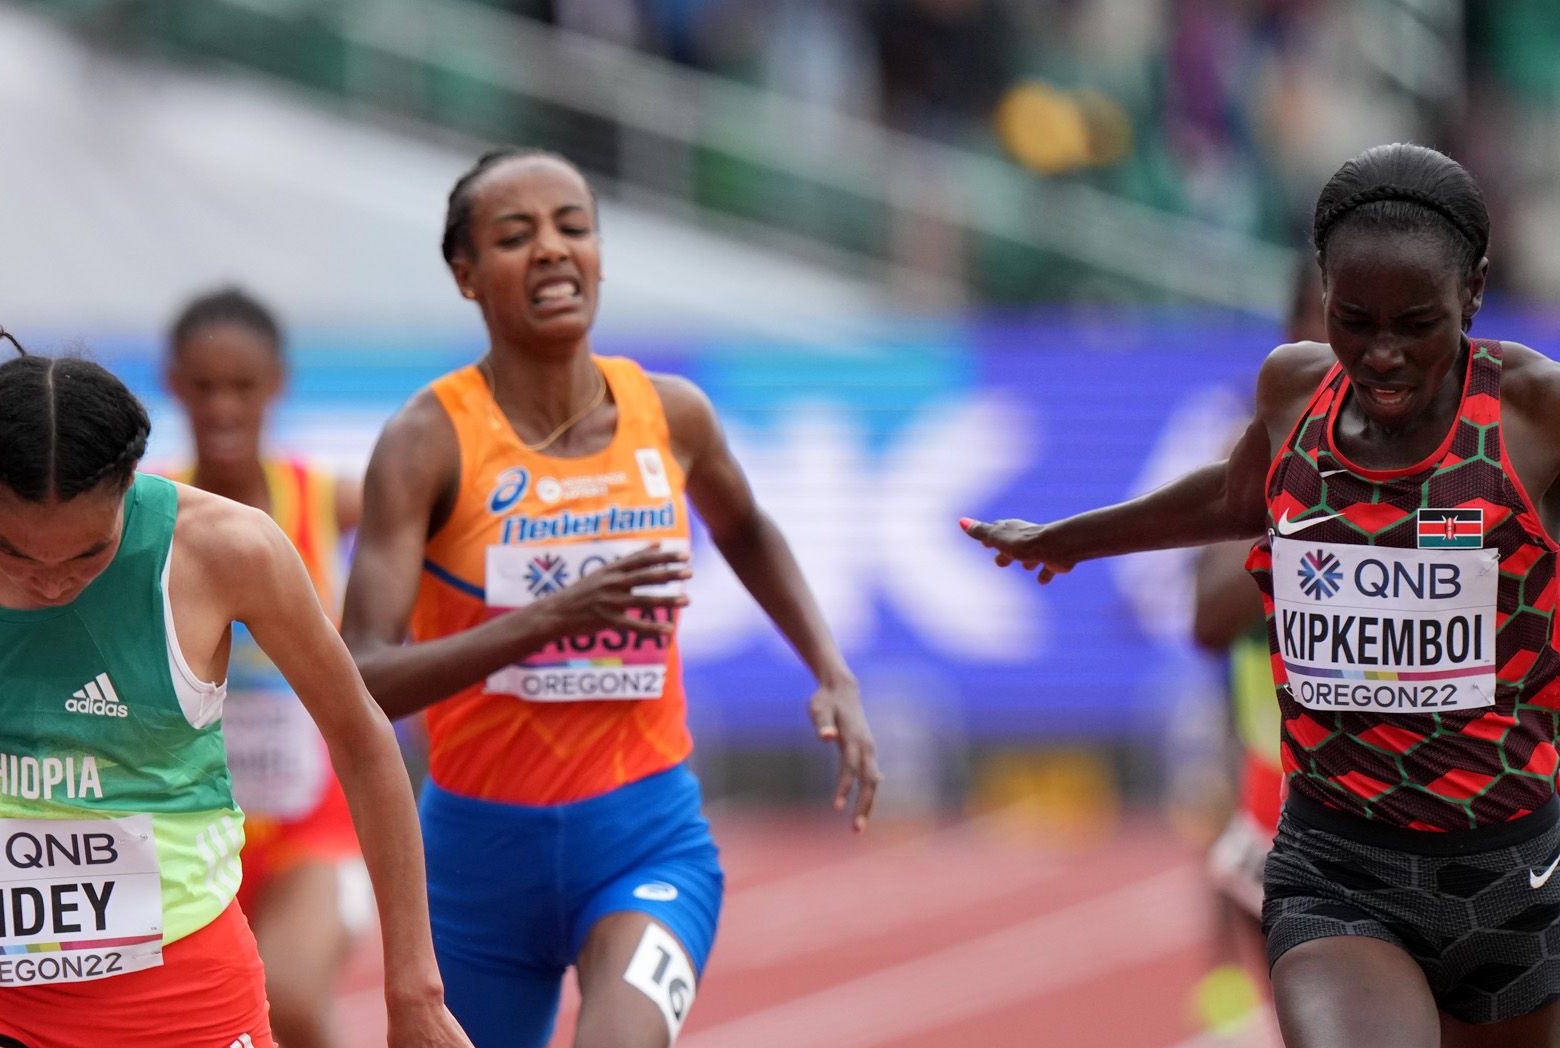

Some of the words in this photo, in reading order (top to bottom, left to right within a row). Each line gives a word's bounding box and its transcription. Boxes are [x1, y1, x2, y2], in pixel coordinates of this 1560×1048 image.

[1354, 558, 1462, 599] QNB
[1282, 609, 1482, 666] KIPKEMBOI
[522, 671, 660, 695] OREGON2
[1300, 681, 1458, 708] OREGON22
[65, 698, 128, 718] adidas
[5, 832, 118, 869] QNB
[652, 945, 689, 1021] 16
